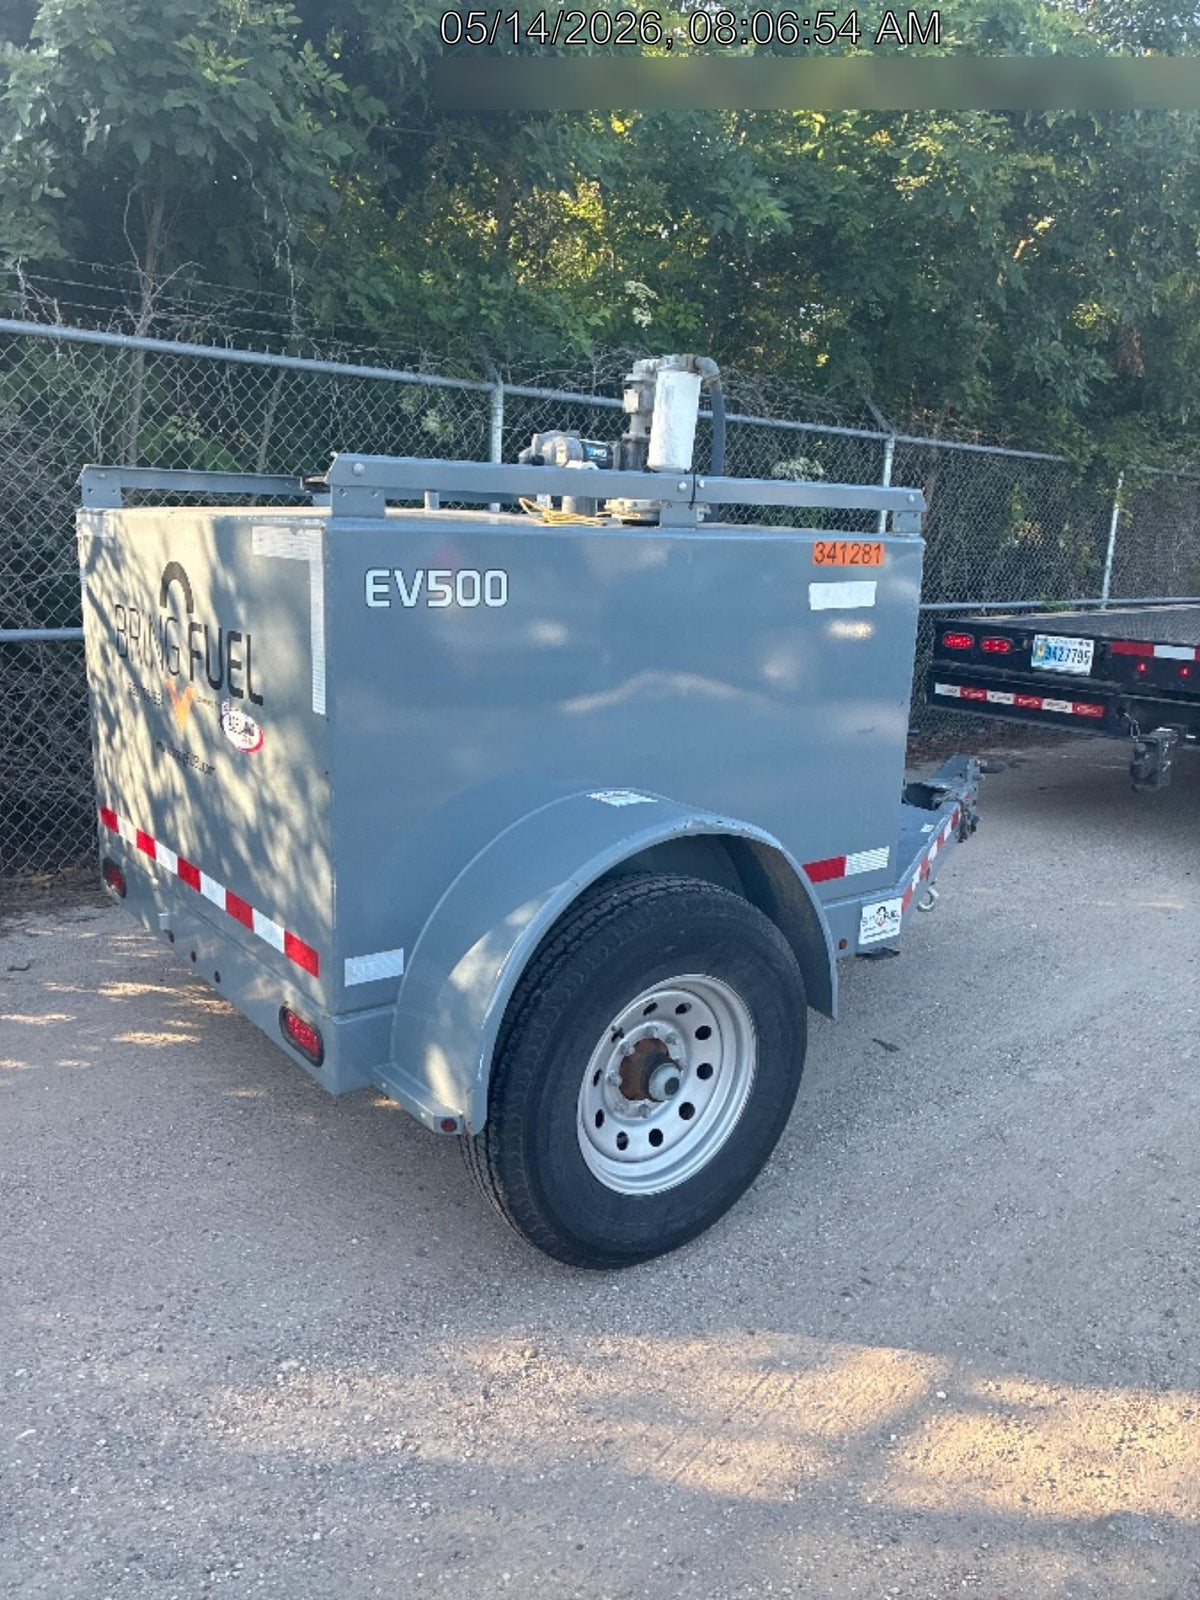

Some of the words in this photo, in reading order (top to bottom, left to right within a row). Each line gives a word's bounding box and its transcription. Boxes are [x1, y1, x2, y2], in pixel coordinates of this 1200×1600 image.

[814, 541, 881, 564] 341281
[365, 568, 509, 608] EV500
[114, 603, 180, 677] BRING
[187, 620, 264, 707] FUEL
